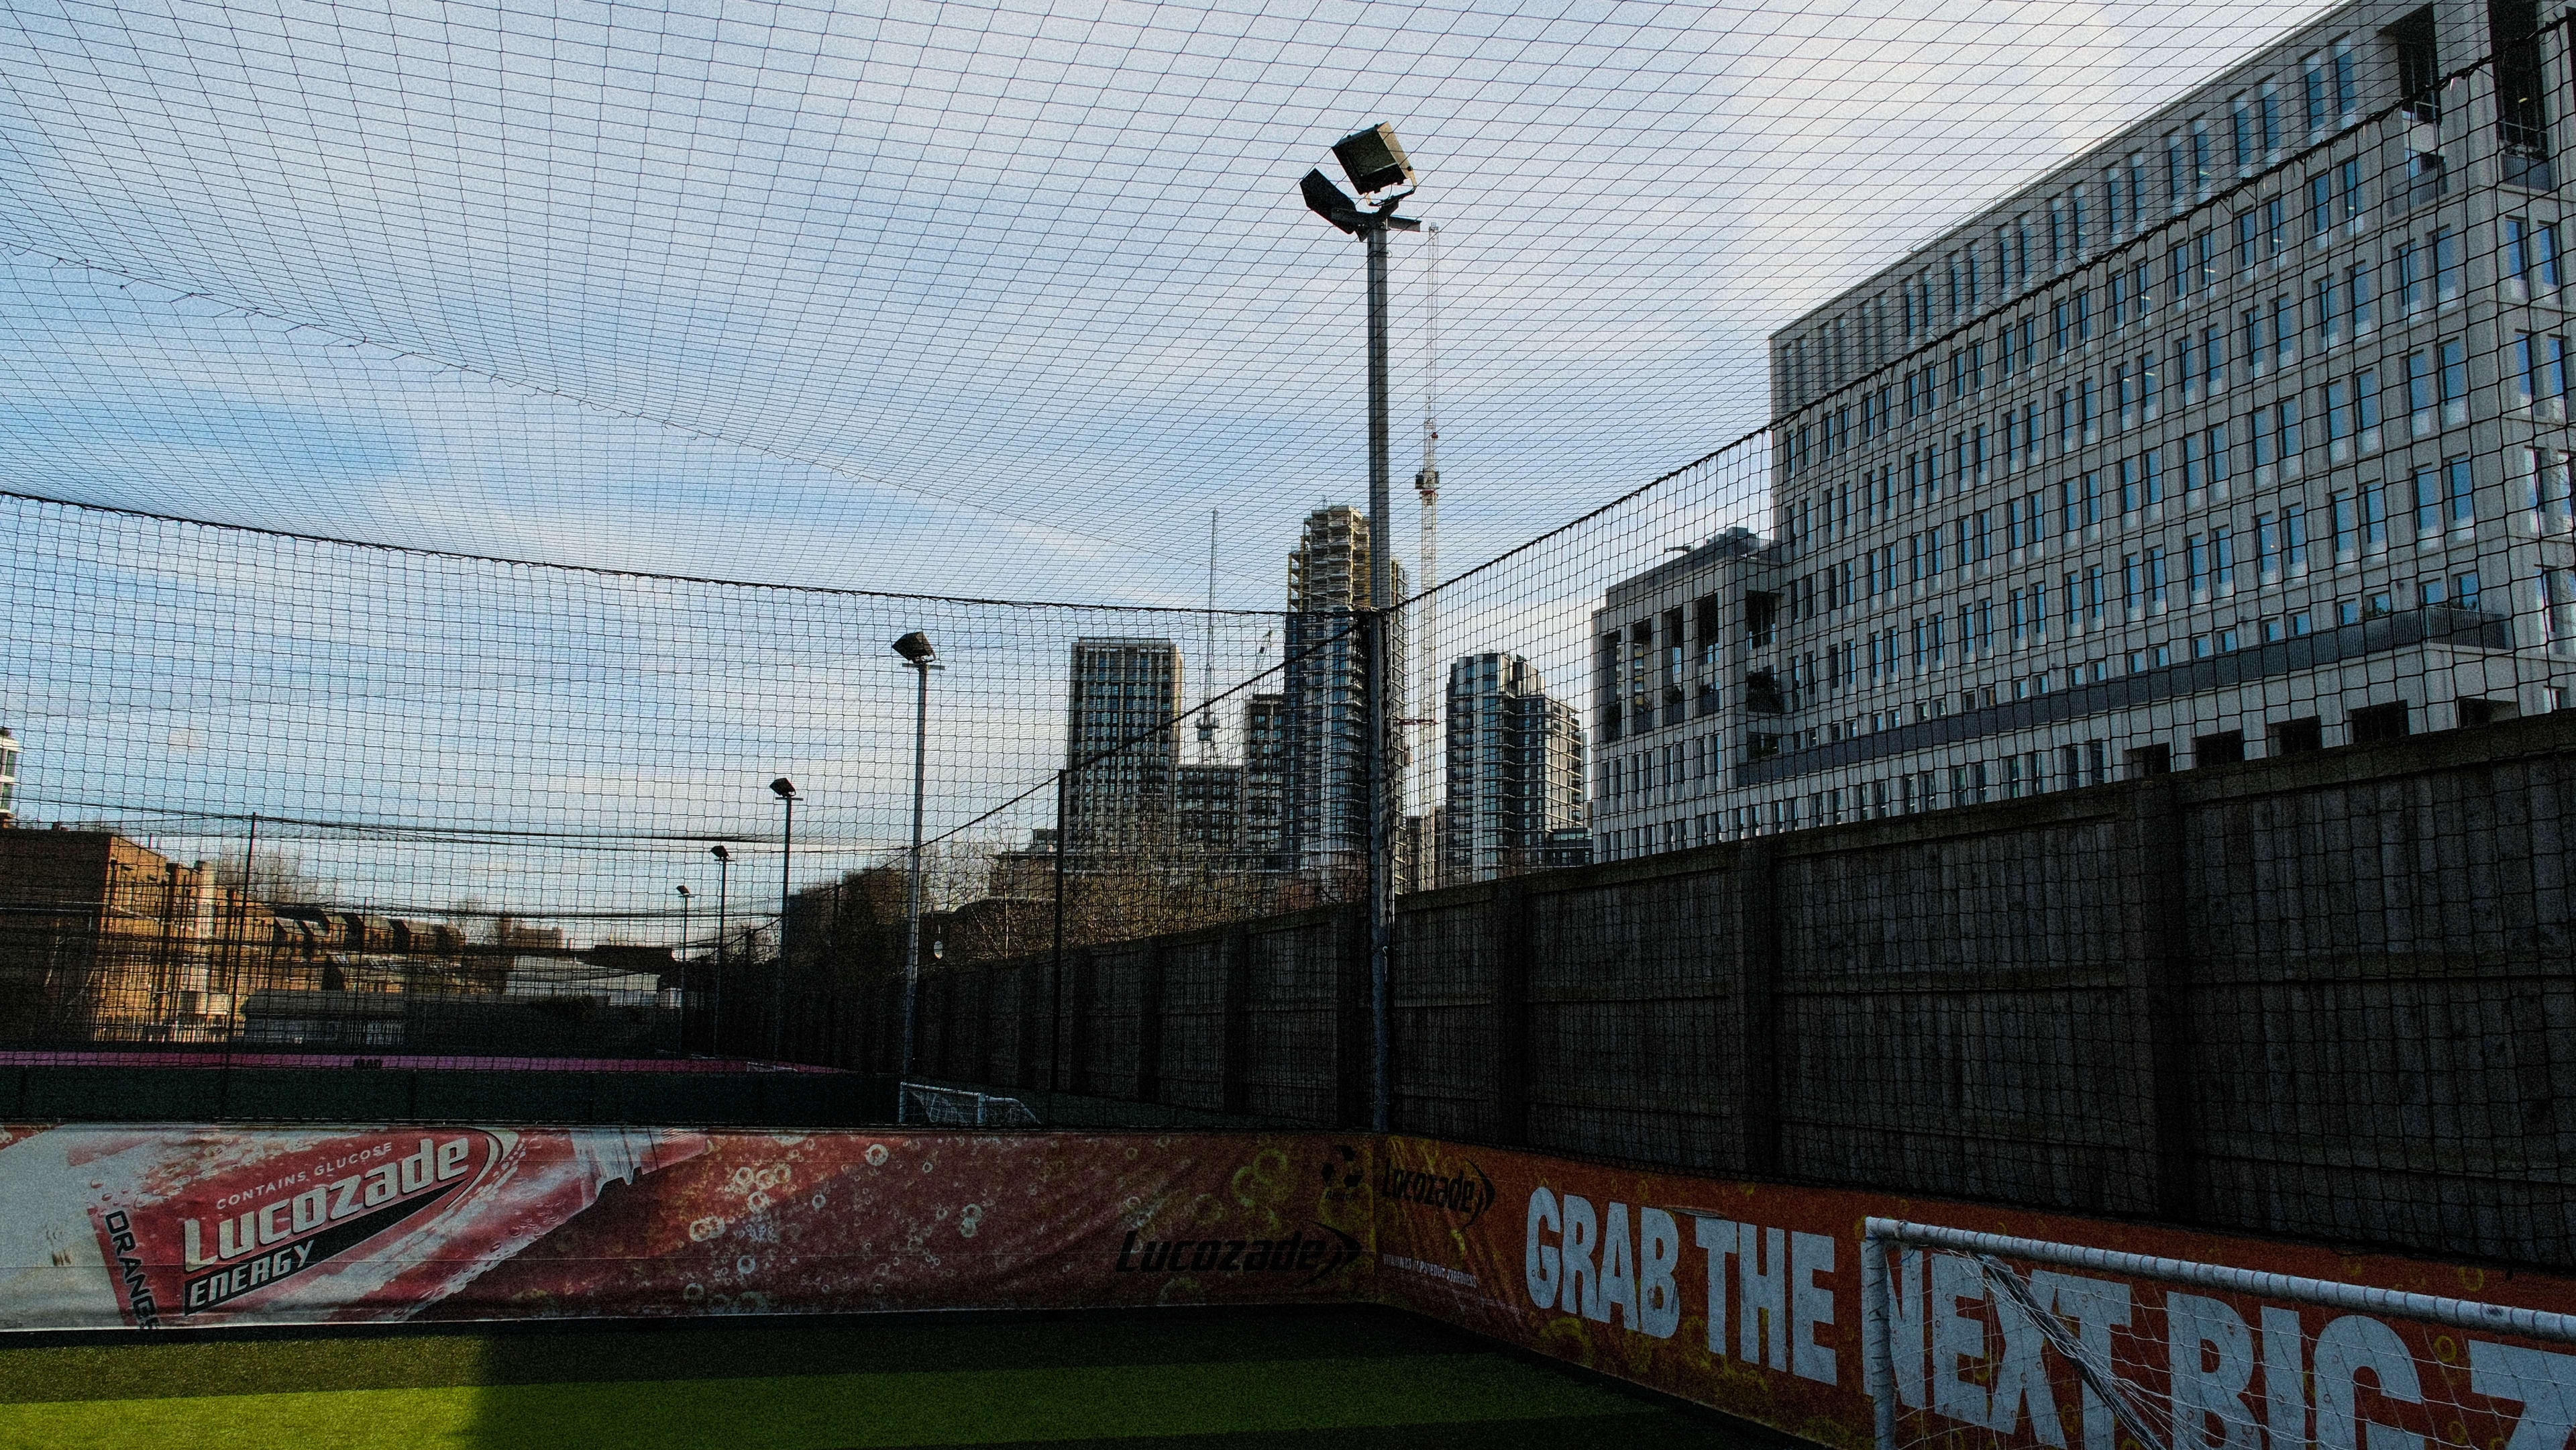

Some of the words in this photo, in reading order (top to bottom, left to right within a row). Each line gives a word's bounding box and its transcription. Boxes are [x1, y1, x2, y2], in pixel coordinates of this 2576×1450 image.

[184, 1137, 470, 1274] Lucozade
[217, 1171, 307, 1209] CONTAINS
[314, 1142, 392, 1177] GLUCOSE
[1382, 1157, 1474, 1212] Lucozade
[189, 1239, 315, 1308] ENERGY
[1116, 1231, 1326, 1273] Lucozade
[1525, 1186, 1680, 1339] GRAB
[1695, 1216, 1838, 1386] THE
[1860, 1241, 2132, 1450] NEXT
[2166, 1290, 2425, 1450] BIG
